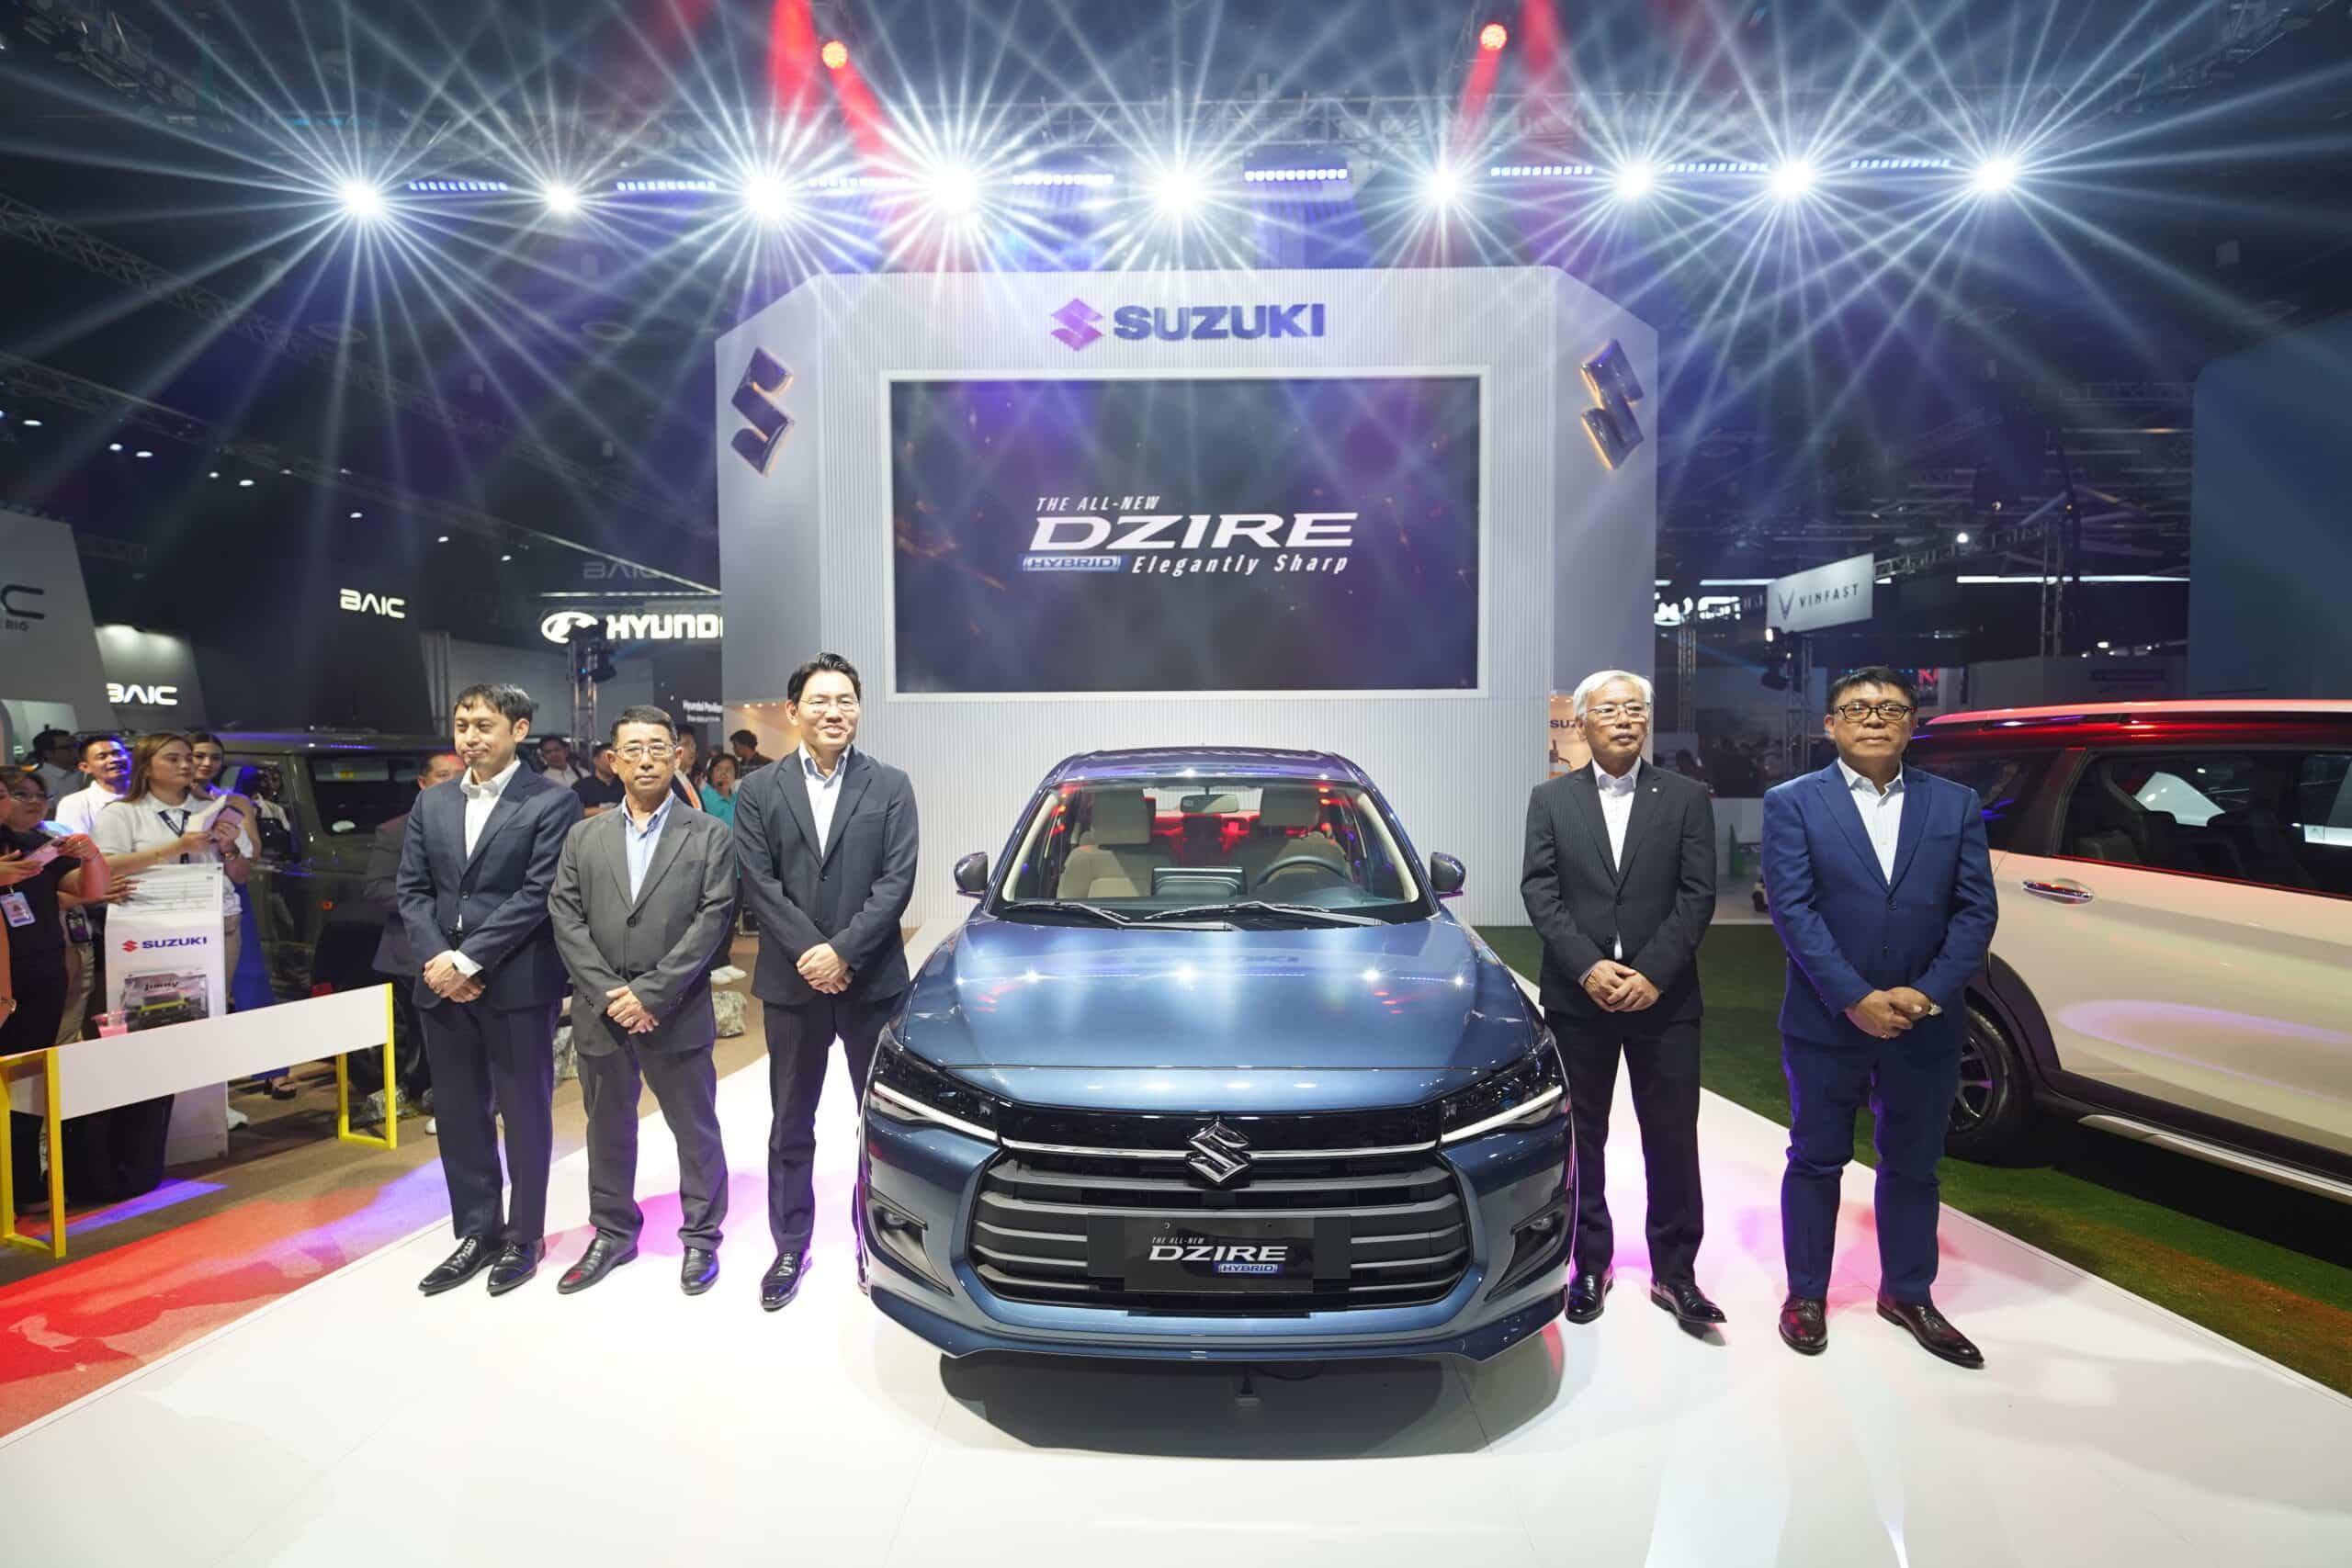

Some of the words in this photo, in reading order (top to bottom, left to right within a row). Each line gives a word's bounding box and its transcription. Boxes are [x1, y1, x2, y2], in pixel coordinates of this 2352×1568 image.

[1114, 304, 1325, 341] SUZUKI
[1036, 497, 1069, 512] THE
[1077, 496, 1160, 511] ALL-NEW
[1029, 512, 1359, 551] DZIRE
[1028, 557, 1115, 569] HYBRID
[1132, 555, 1260, 578] Elegantly
[1274, 553, 1349, 575] Sharp
[339, 588, 406, 619] BAIC
[1799, 582, 1859, 608] VINFAST
[606, 615, 723, 640] HYUND
[106, 682, 178, 705] BAIC
[141, 936, 208, 949] SUZUKI
[1148, 1246, 1288, 1261] DZIRE
